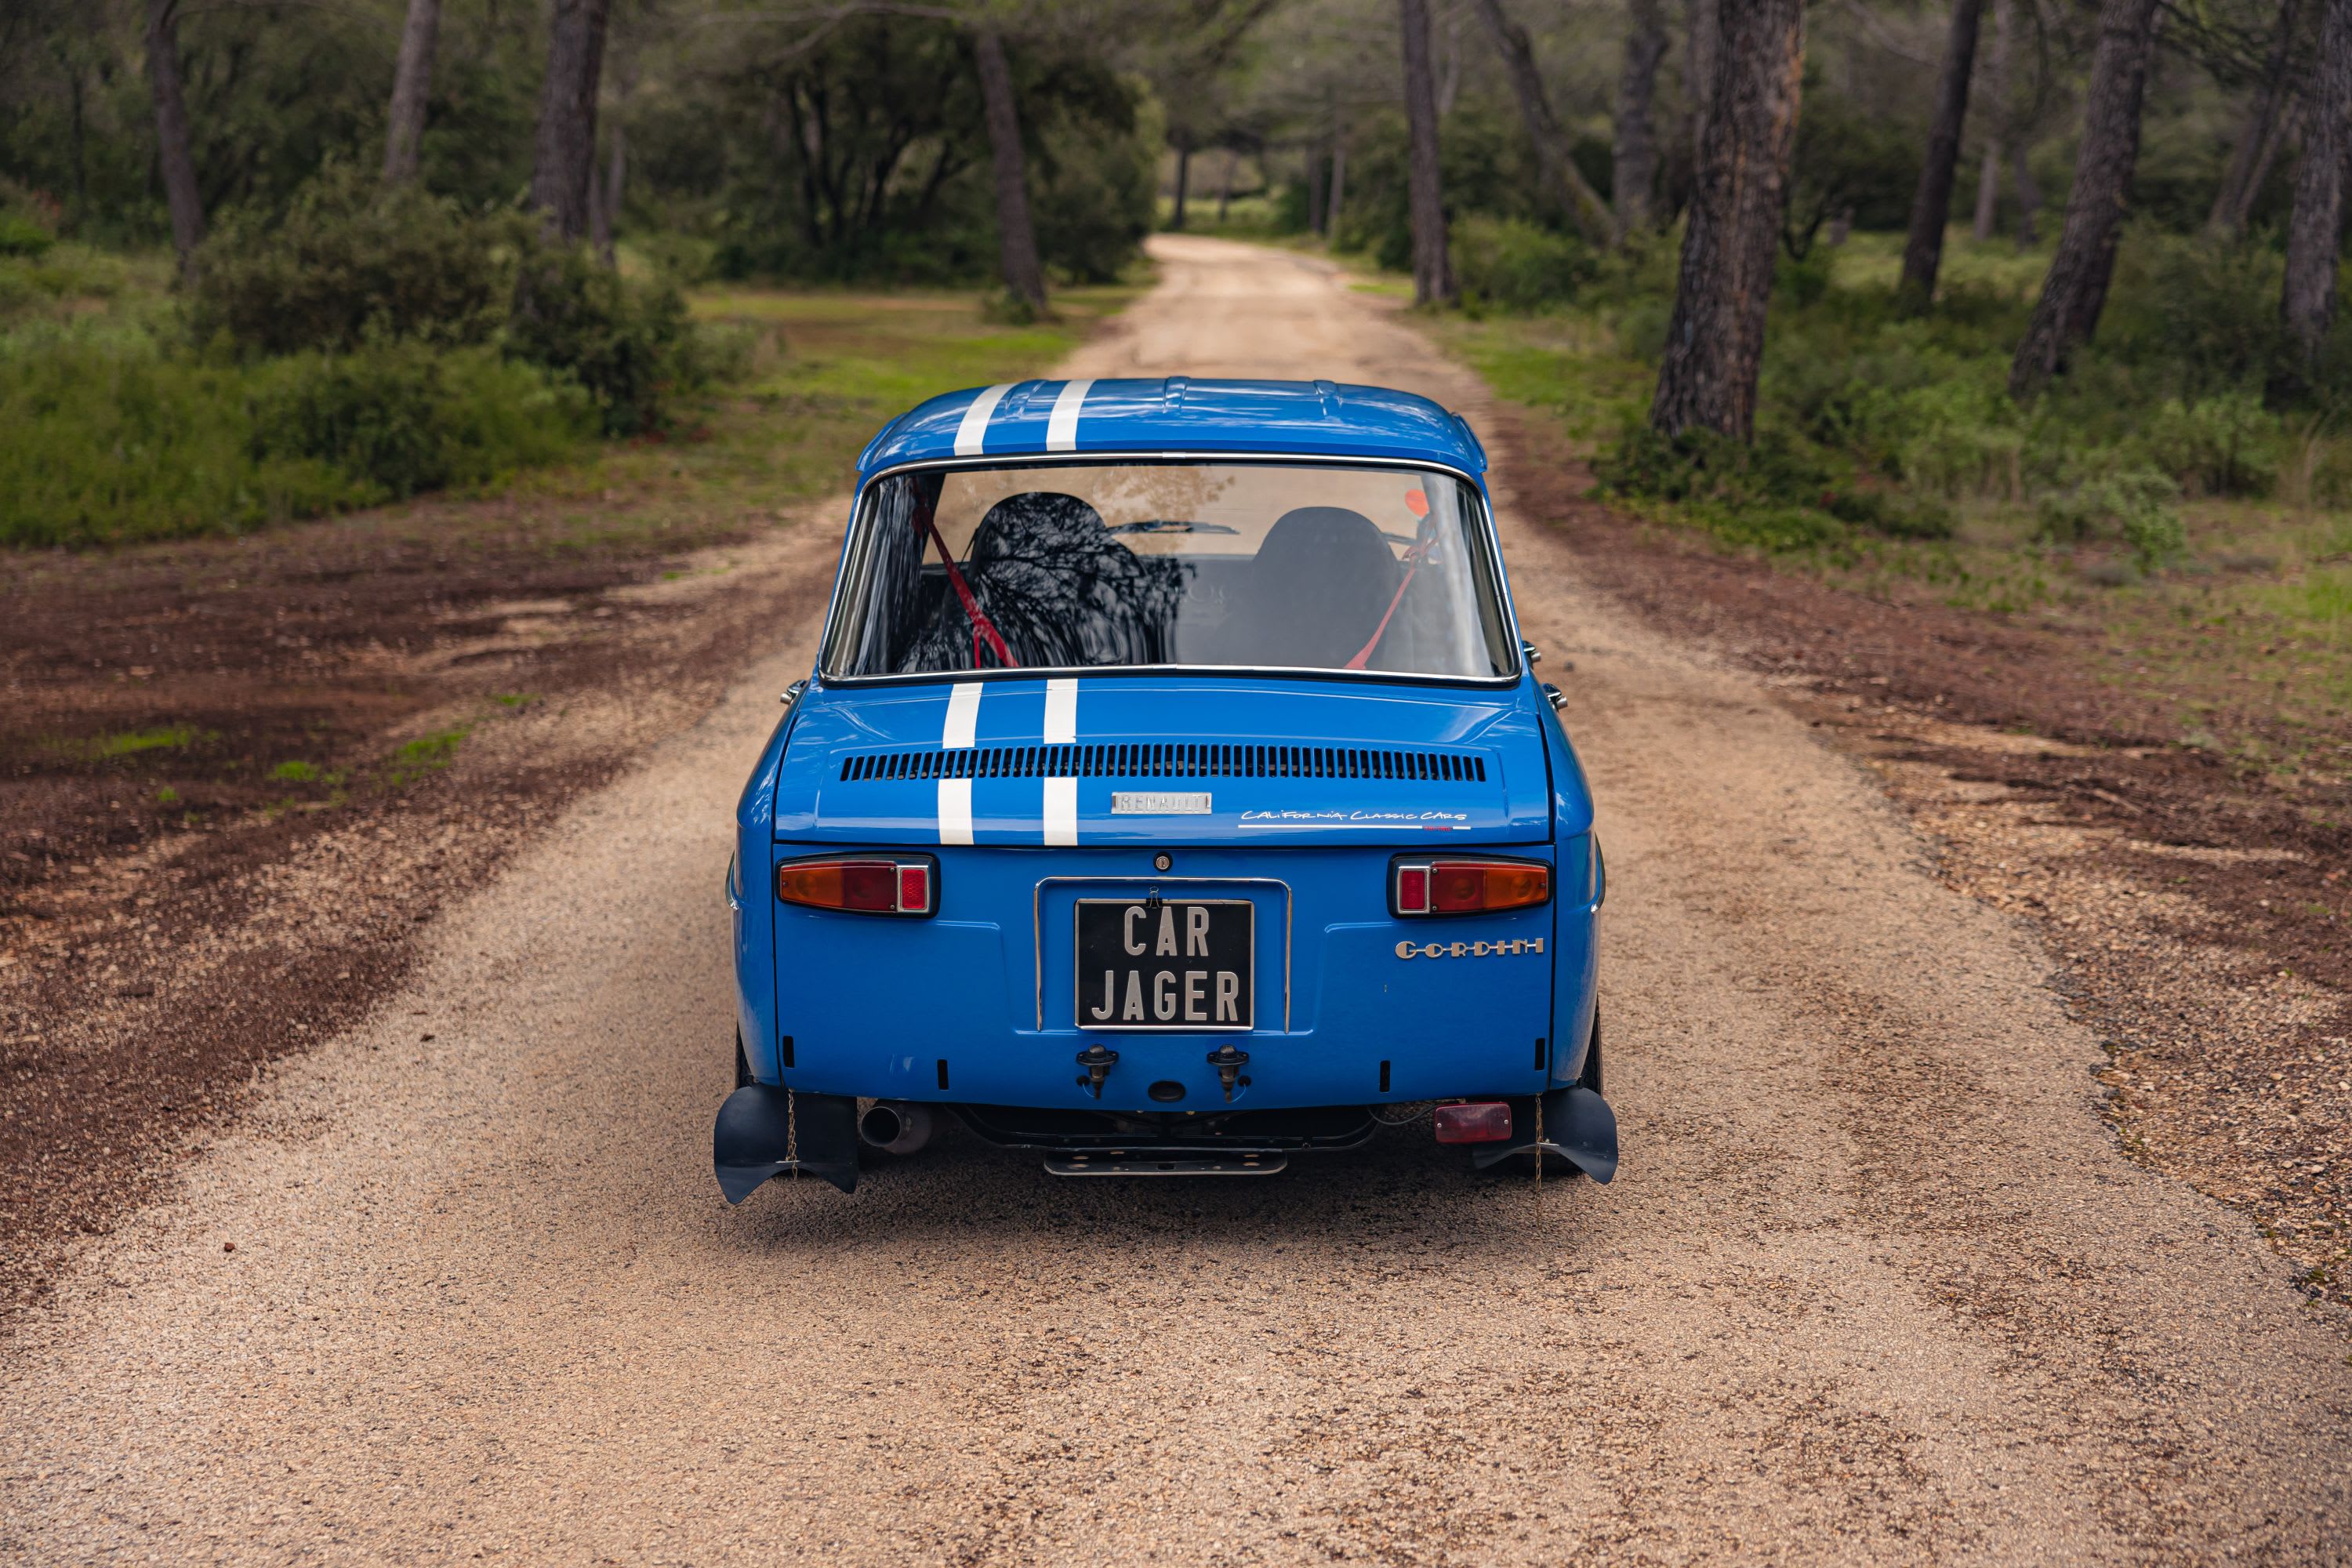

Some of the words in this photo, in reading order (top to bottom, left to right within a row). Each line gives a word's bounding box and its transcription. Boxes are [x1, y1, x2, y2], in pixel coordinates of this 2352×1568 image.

[1120, 794, 1203, 811] RENAULT
[1123, 906, 1210, 956] CAR
[1091, 970, 1239, 1022] JAGER
